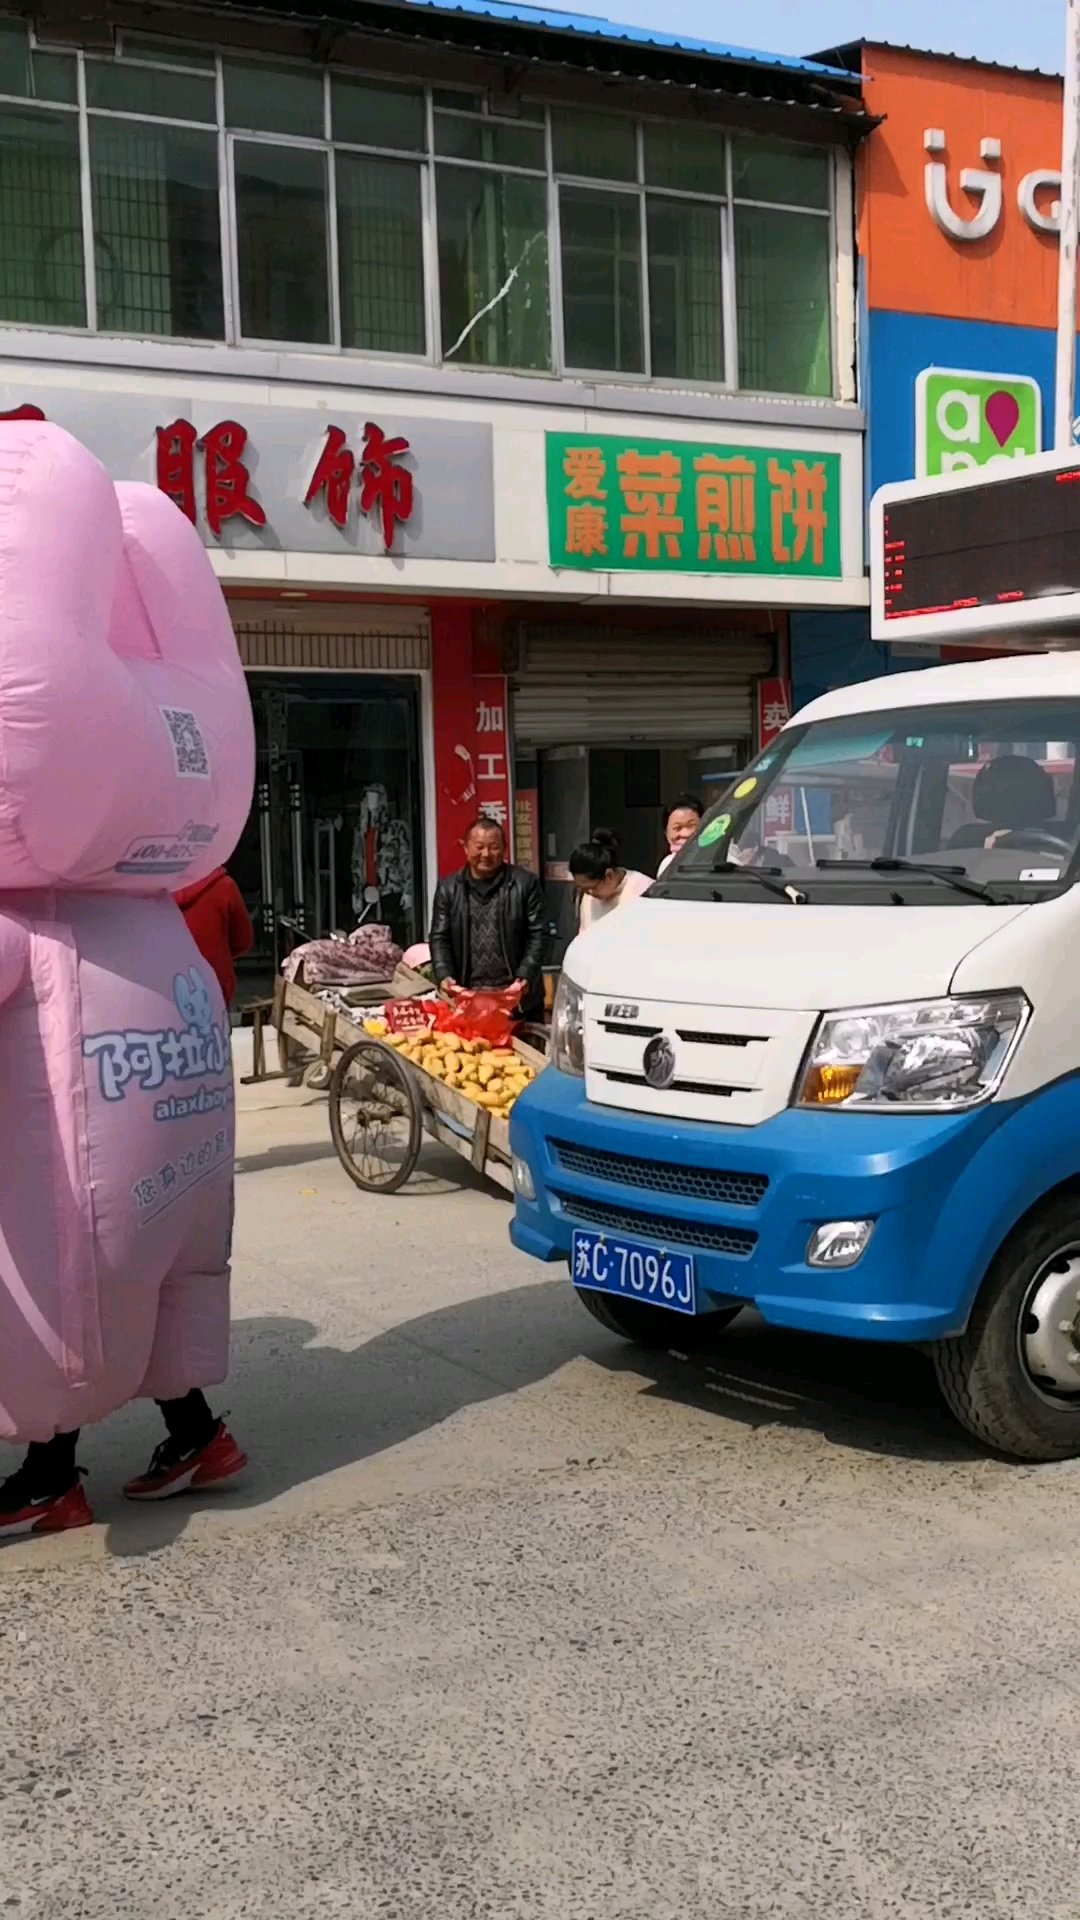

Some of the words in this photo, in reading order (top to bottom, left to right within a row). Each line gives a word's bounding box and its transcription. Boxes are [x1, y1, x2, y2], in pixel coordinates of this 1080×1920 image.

[155, 417, 414, 552] 服饰
[563, 446, 609, 557] 爱康
[616, 448, 828, 565] 菜煎饼
[83, 1020, 230, 1101] 阿拉小
